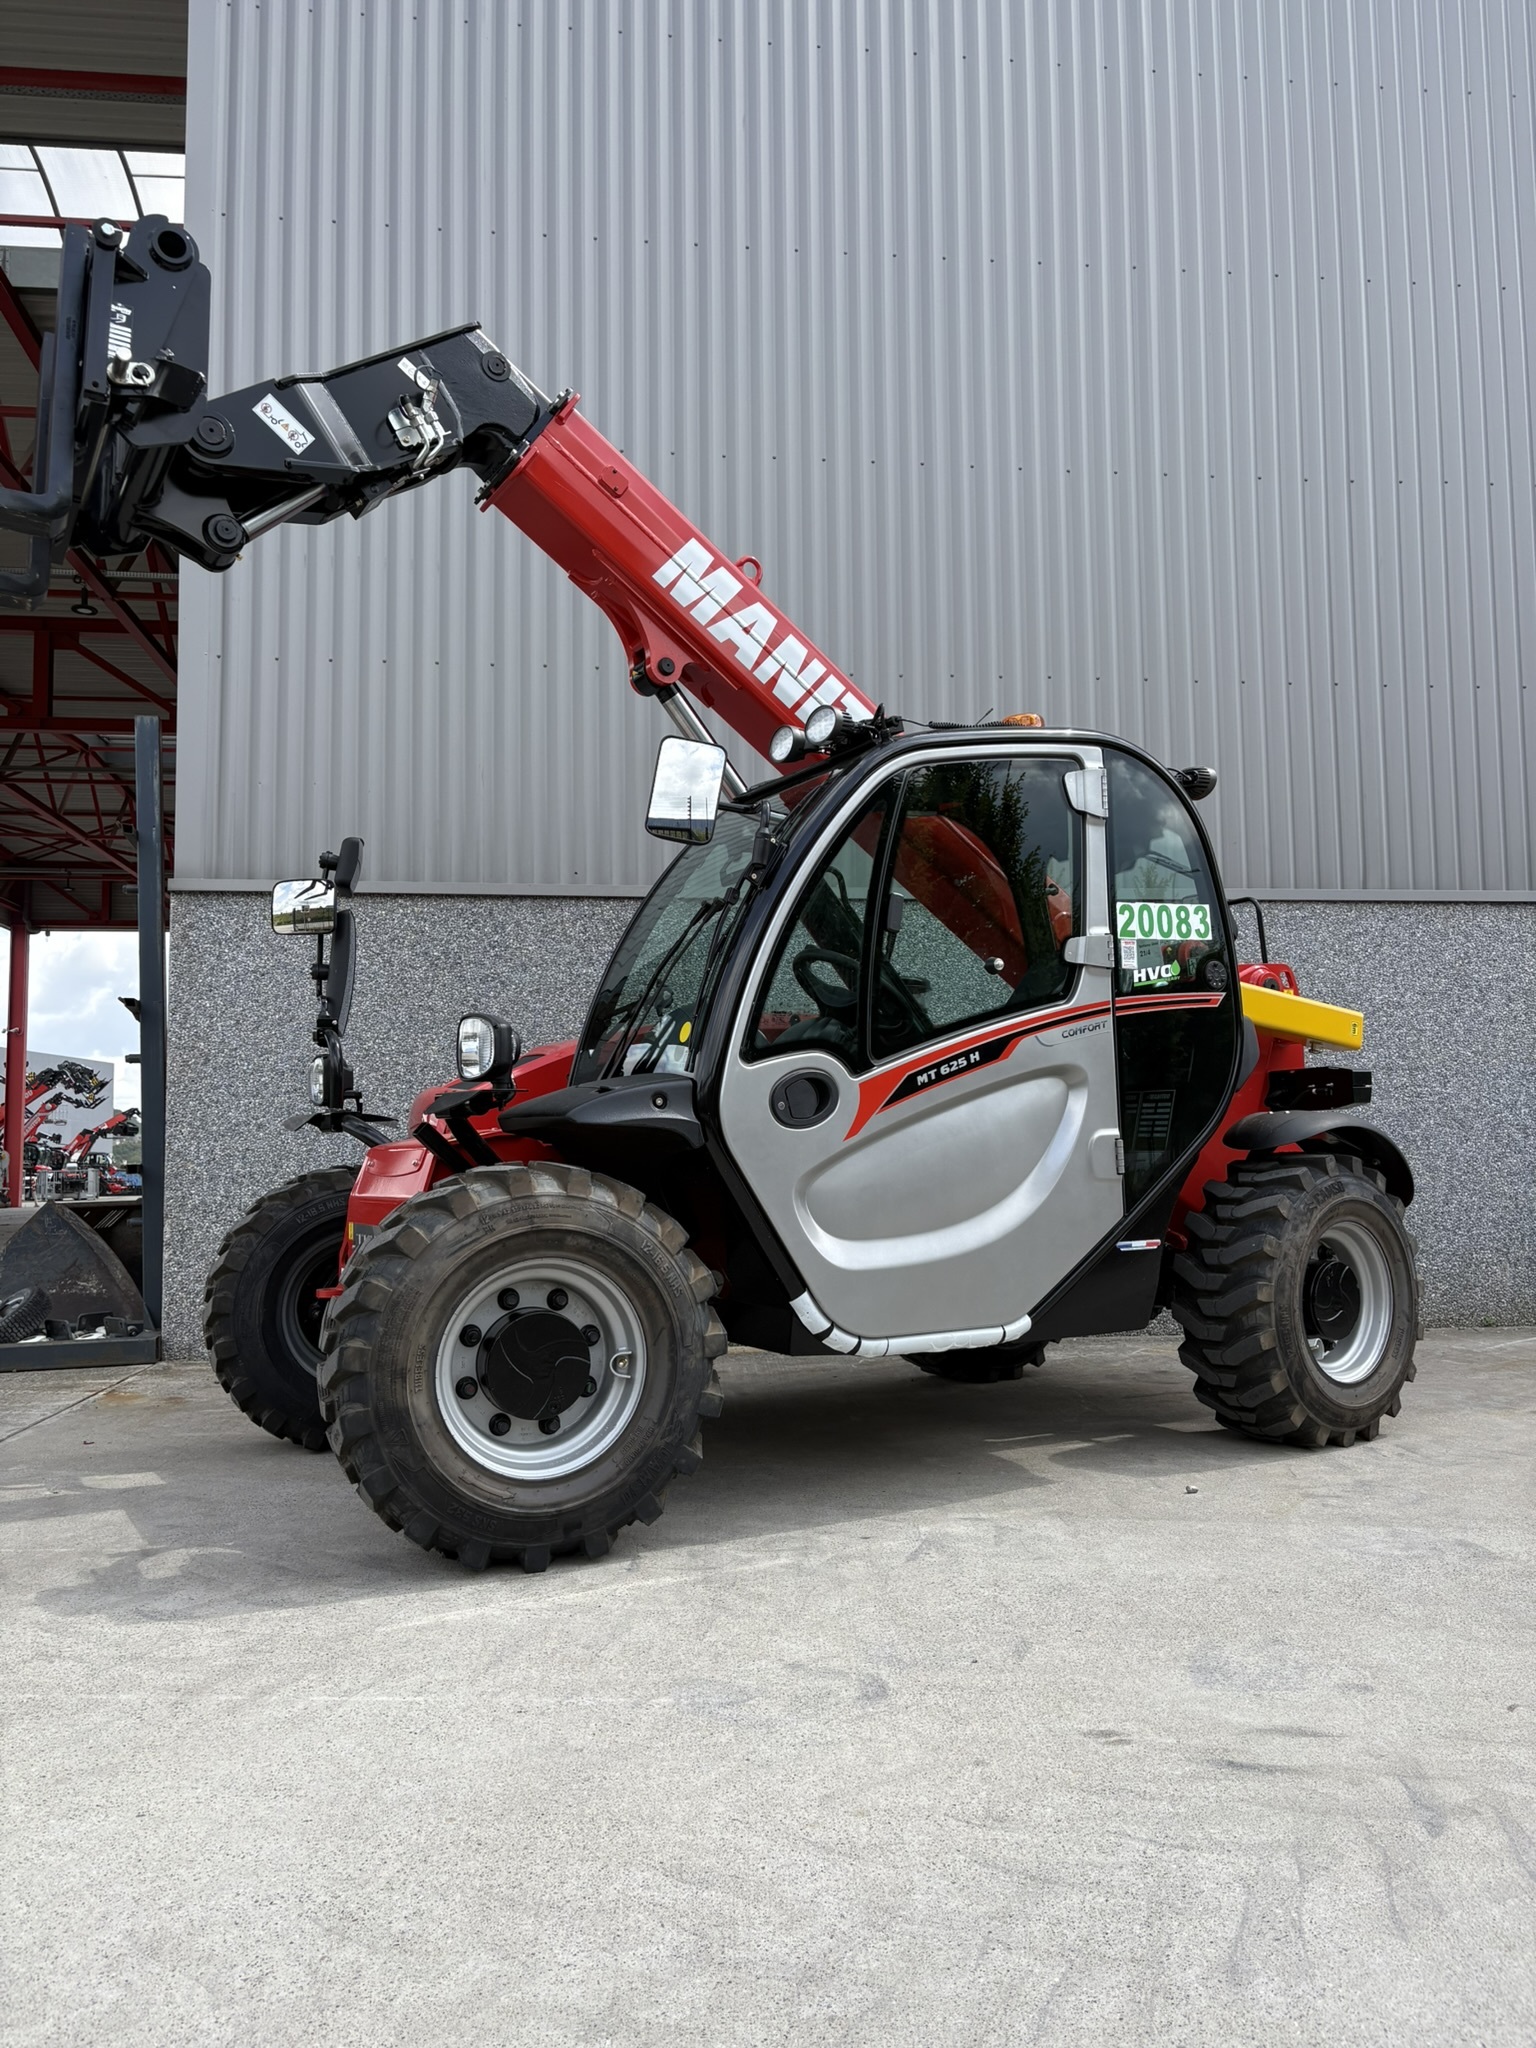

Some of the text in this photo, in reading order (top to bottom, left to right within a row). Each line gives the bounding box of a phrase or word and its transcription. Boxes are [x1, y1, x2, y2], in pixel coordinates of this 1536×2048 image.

[1118, 903, 1210, 939] 20083
[1133, 964, 1173, 982] HVO
[1061, 1020, 1108, 1039] COMFORT
[916, 1050, 981, 1086] MT 625 H
